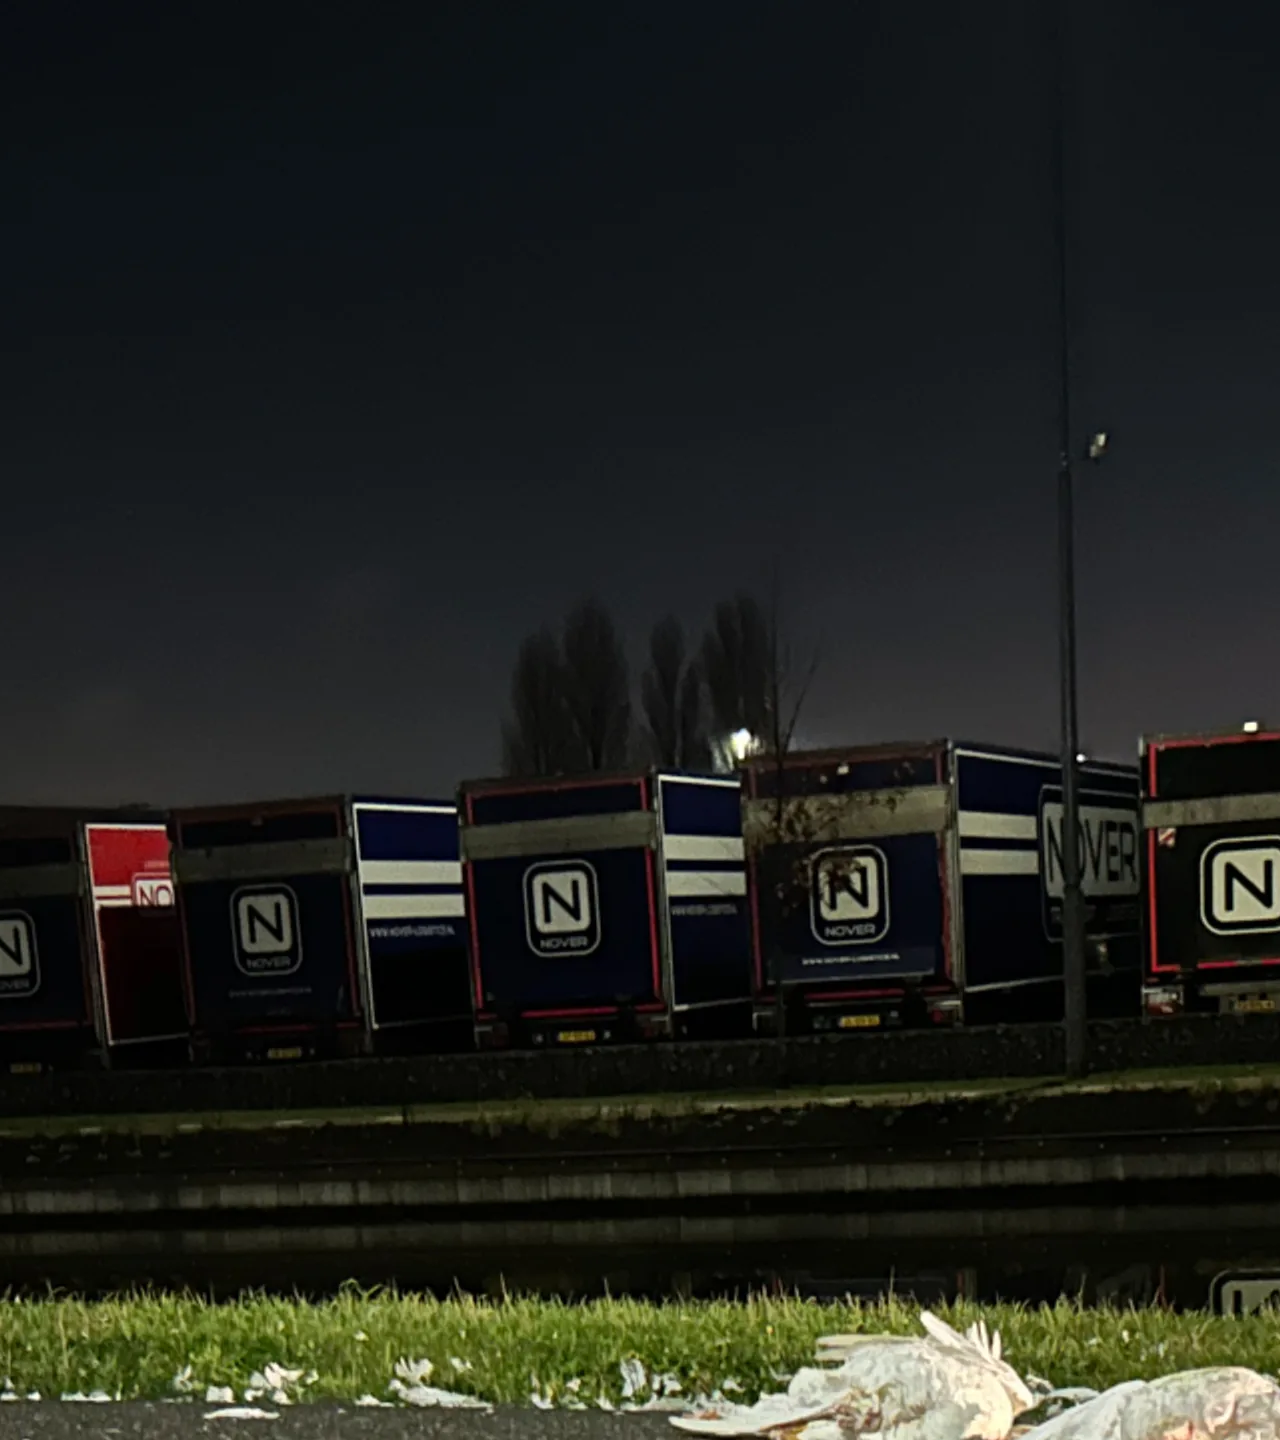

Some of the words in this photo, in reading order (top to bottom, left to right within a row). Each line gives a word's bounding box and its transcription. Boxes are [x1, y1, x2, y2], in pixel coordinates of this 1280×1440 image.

[542, 880, 581, 923] N
[829, 865, 869, 911] N
[1225, 859, 1273, 912] N
[247, 902, 283, 943] N
[539, 936, 589, 949] NOVER
[824, 923, 876, 937] NOVER
[246, 955, 292, 969] NOVER
